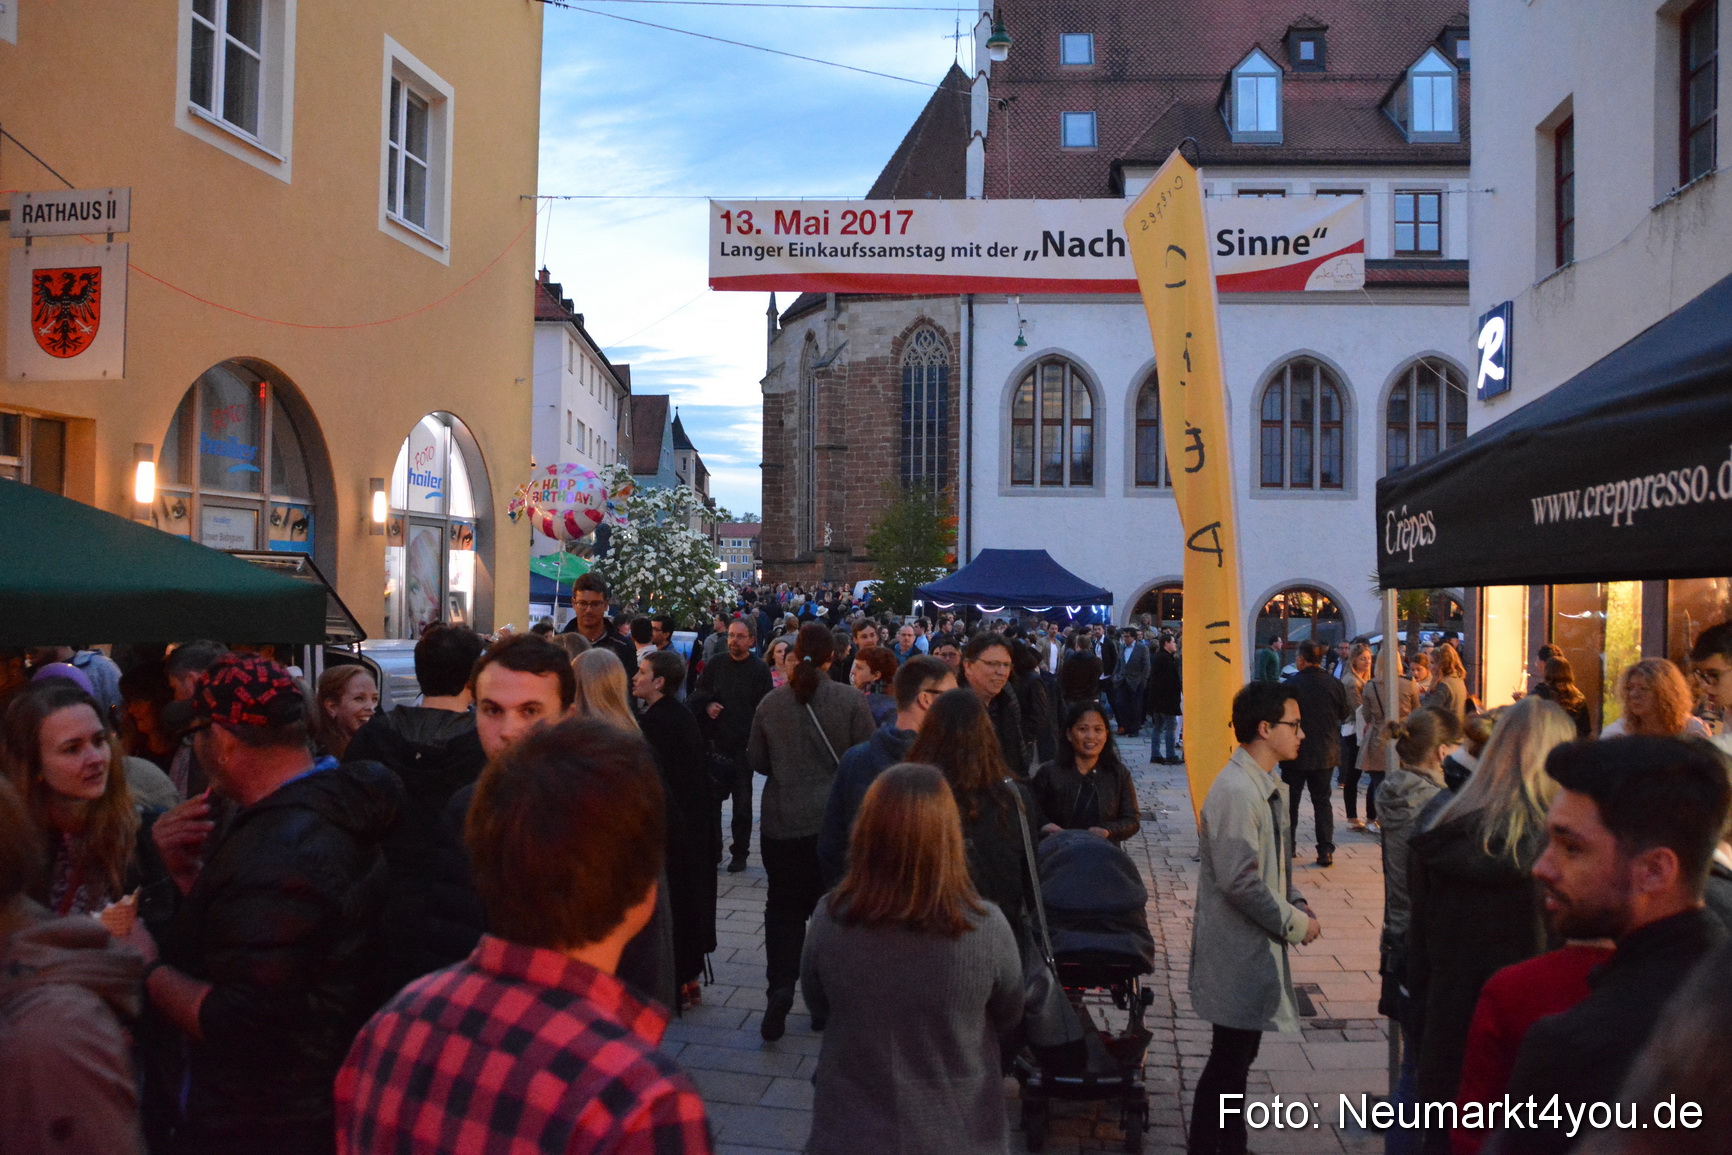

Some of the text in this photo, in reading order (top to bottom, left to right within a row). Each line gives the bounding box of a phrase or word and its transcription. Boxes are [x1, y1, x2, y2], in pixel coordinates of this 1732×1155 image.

[22, 200, 116, 223] RATHAUS II
[720, 209, 914, 235] 13. Mai 2017
[720, 241, 783, 260] Langer
[788, 242, 946, 261] Einkaufssamstag
[951, 242, 982, 258] mit
[987, 242, 1018, 258] der
[1023, 229, 1131, 261] „Nach
[1477, 316, 1505, 389] R
[199, 431, 258, 461] hailer
[408, 467, 443, 489] hailer
[542, 478, 586, 491] HAPPY
[532, 490, 594, 506] BIRTHDAY!
[1385, 505, 1437, 563] Crêpes
